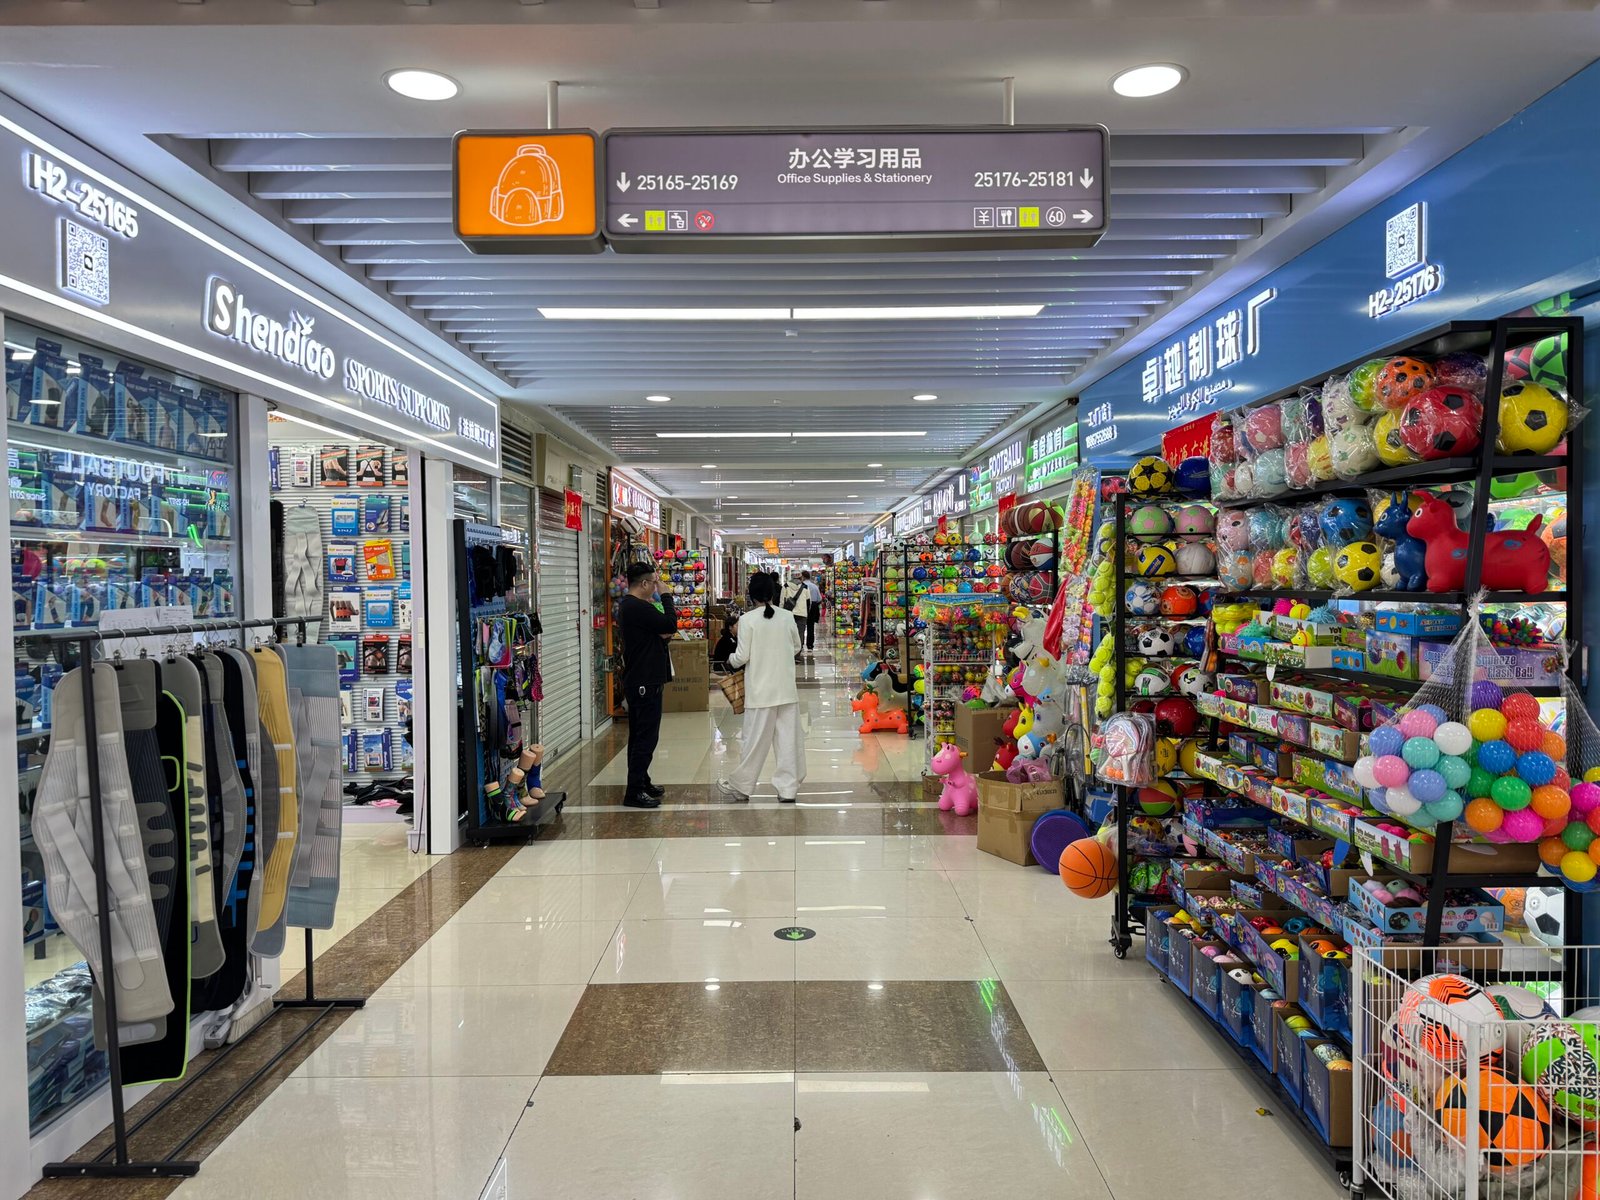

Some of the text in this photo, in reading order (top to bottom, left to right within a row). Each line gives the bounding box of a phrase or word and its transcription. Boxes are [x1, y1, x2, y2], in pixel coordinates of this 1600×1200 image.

[788, 147, 922, 170] 办公学习用品
[637, 174, 739, 191] 25165-25169
[777, 172, 933, 186] Office Supplies & Stationery
[974, 171, 1074, 188] 25176-25181
[29, 152, 139, 239] H2-25165
[1369, 265, 1442, 318] H2-25176
[209, 280, 336, 379] Shendiao
[1142, 289, 1276, 403] 卓越制球厂
[347, 359, 451, 430] SPORTS SUPPORTS
[1088, 402, 1111, 427] 工厂店
[989, 442, 1023, 479] FOOTBALL
[1476, 654, 1517, 666] Squeeze
[1488, 665, 1514, 679] Flash
